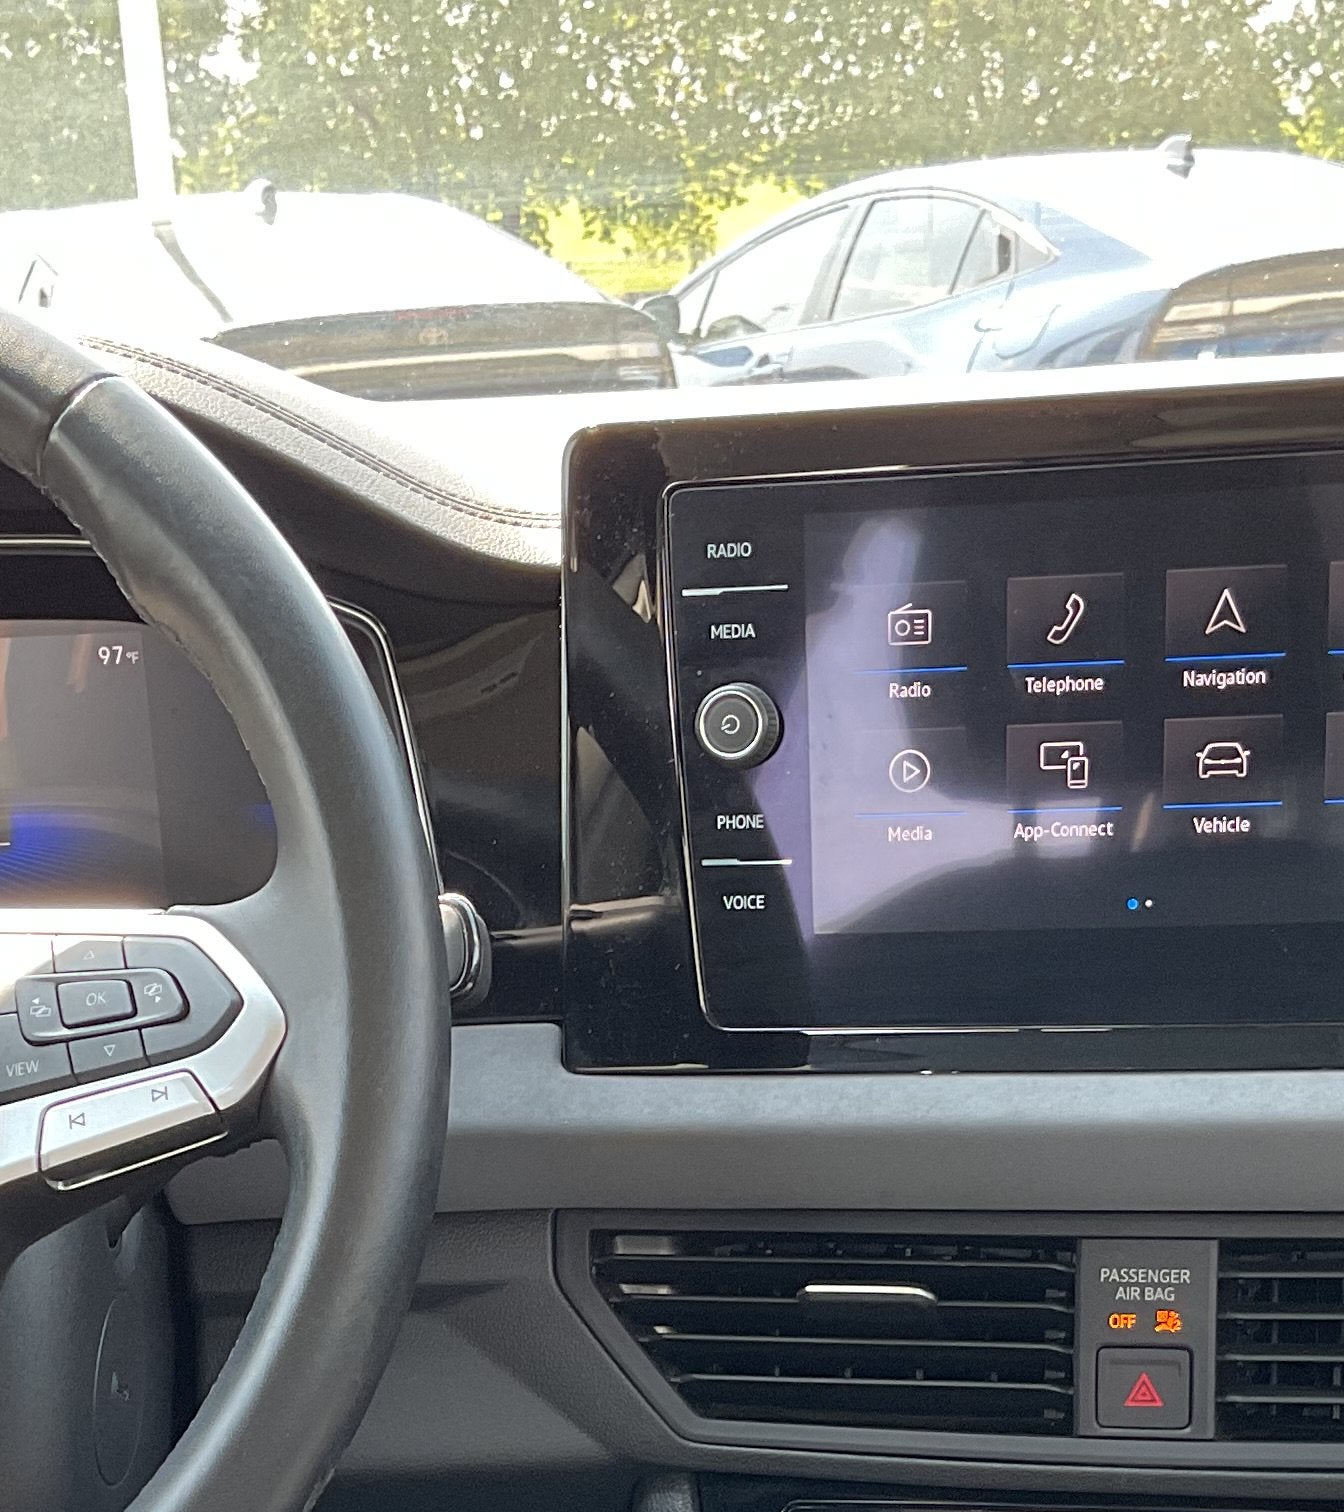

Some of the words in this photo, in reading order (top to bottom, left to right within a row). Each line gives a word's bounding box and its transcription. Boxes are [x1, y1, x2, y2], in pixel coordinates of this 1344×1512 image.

[706, 541, 752, 559] RADIO
[710, 623, 756, 640] MEDIA
[1025, 675, 1104, 695] Telephone
[1182, 667, 1267, 690] Navigation
[888, 682, 931, 699] Radio
[716, 814, 764, 831] PHONE
[1013, 820, 1114, 842] App-Connect
[1193, 814, 1251, 834] Vehicle
[887, 825, 933, 842] Media
[723, 894, 765, 911] VOICE
[85, 991, 106, 1006] OK
[6, 1060, 39, 1077] VIEW
[1100, 1268, 1190, 1284] PASSENGER
[1115, 1286, 1141, 1301] AIR
[1144, 1286, 1175, 1302] BAG
[1108, 1313, 1137, 1329] OFF
